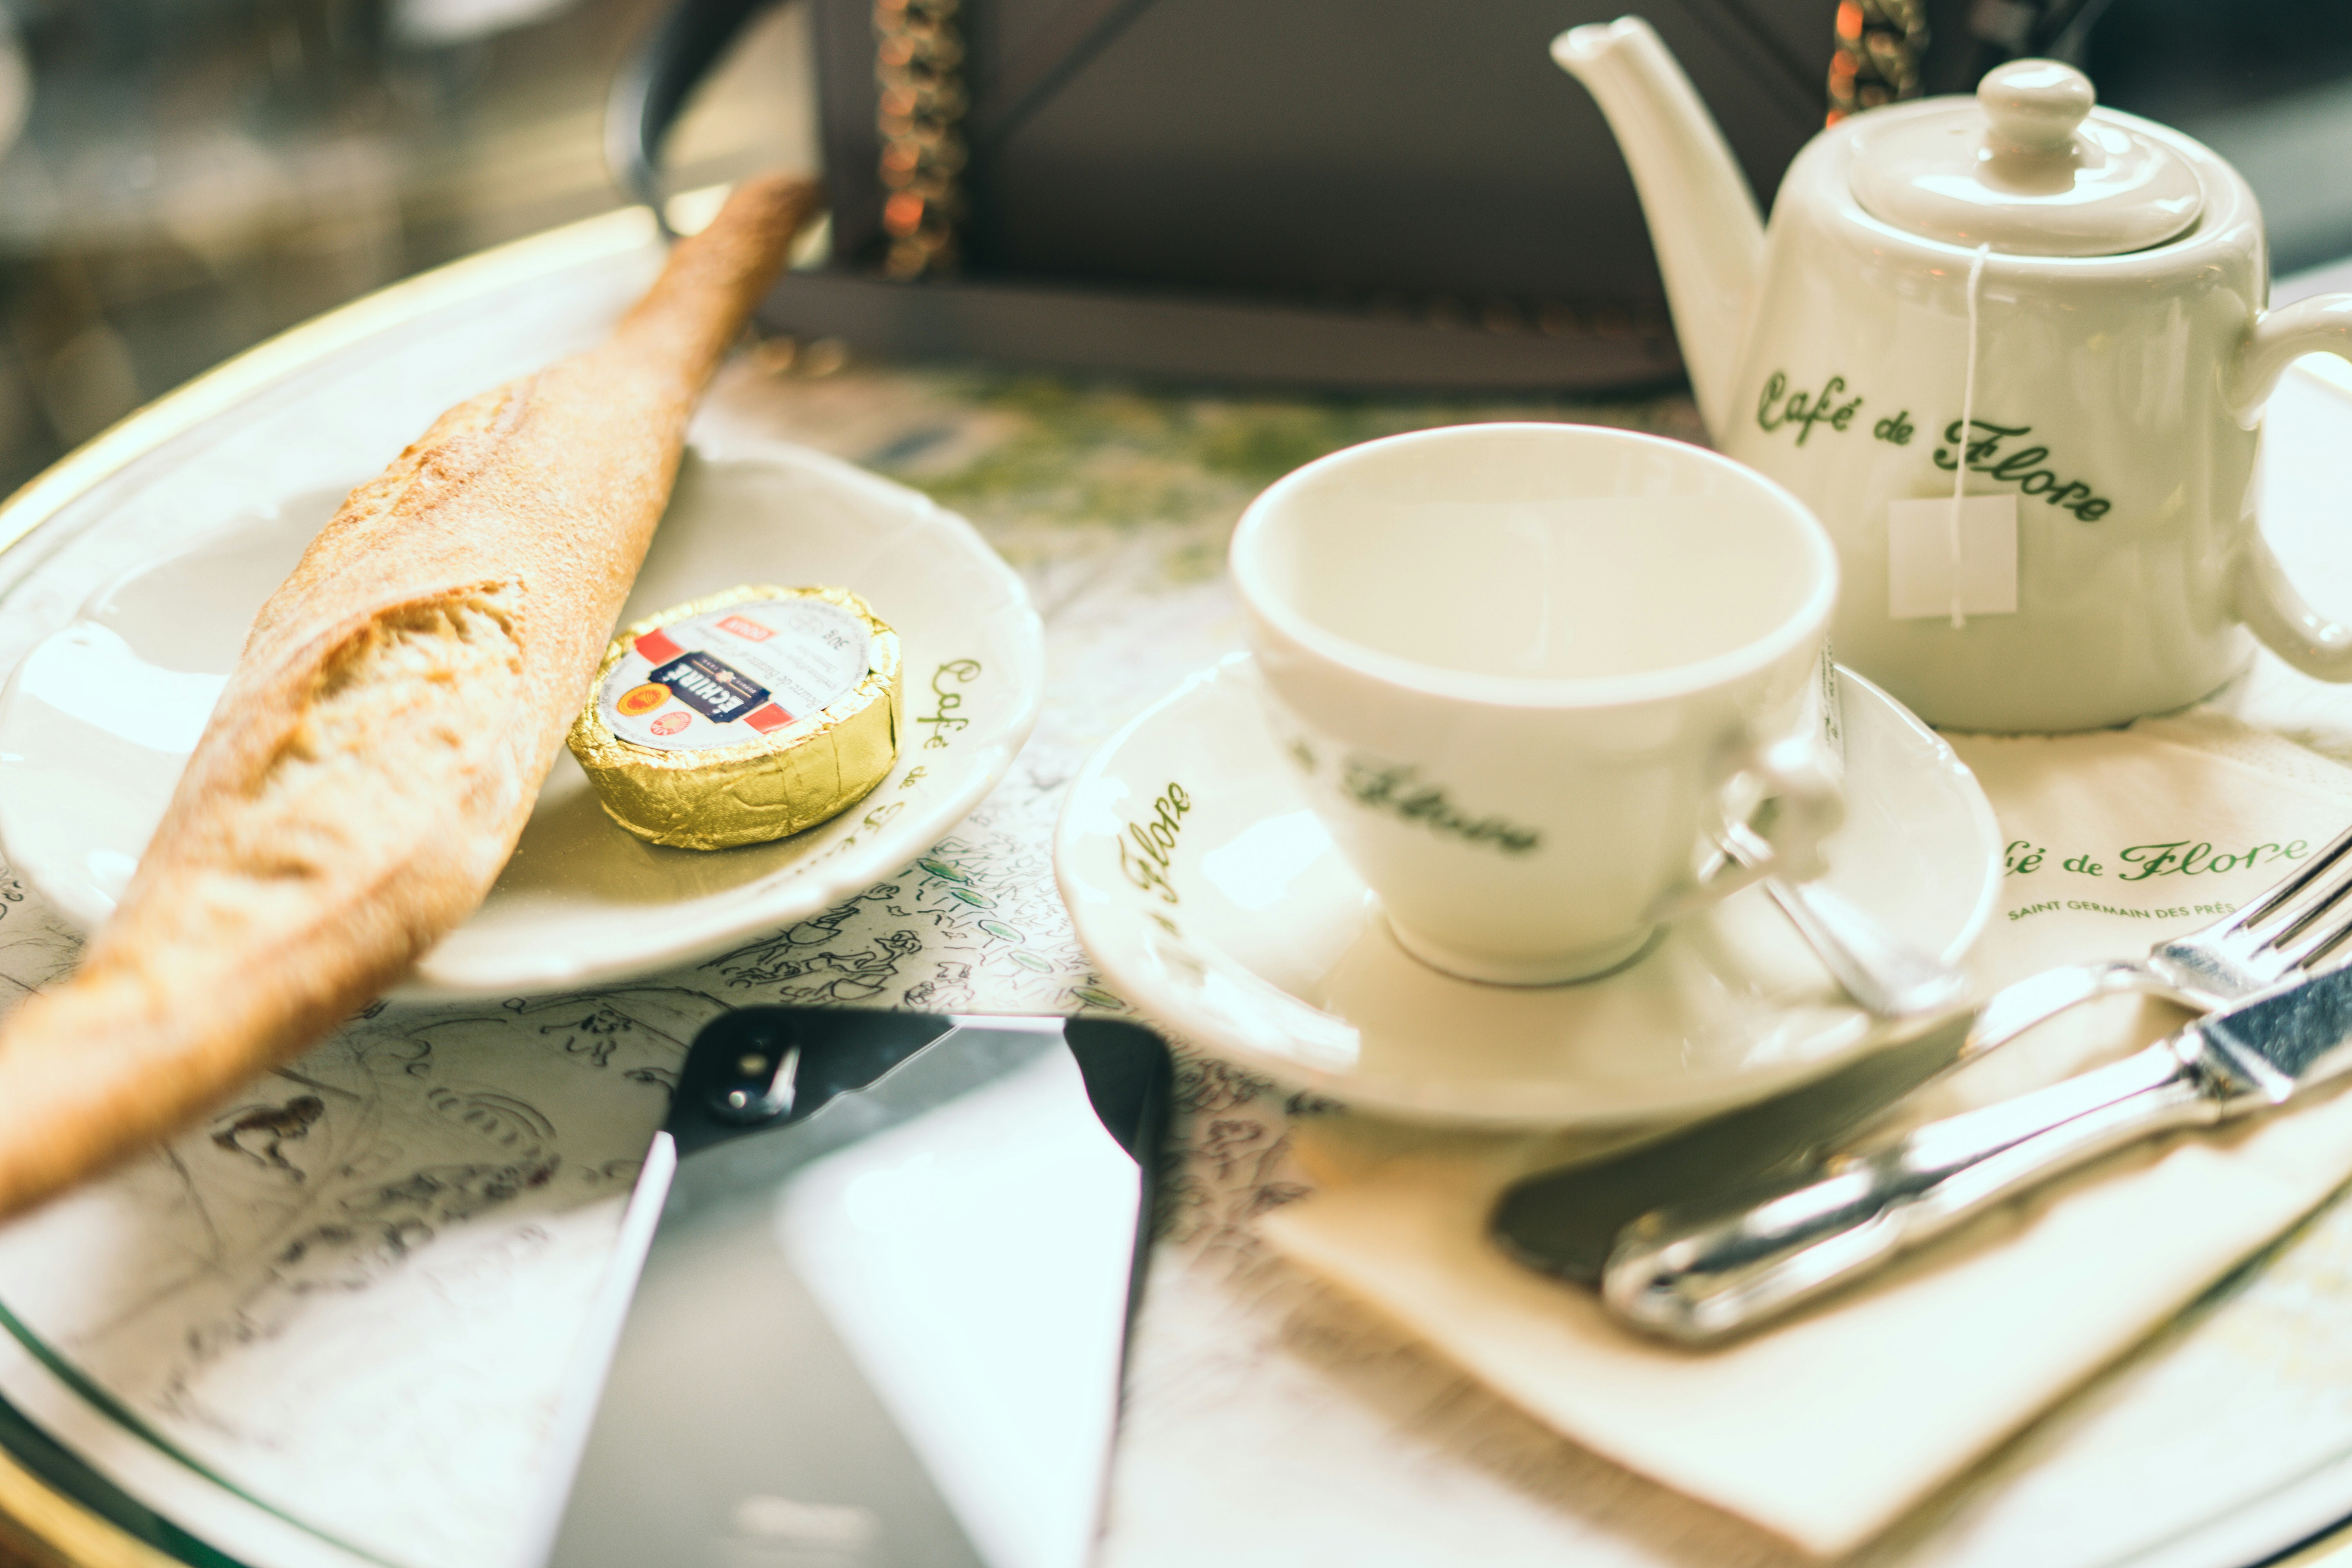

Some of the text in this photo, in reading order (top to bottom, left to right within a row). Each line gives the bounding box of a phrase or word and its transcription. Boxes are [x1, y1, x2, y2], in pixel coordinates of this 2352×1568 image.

[1757, 370, 2112, 522] Café de Flore
[662, 662, 744, 714] ÉCHIRÉ
[735, 680, 757, 693] DEPUIS
[775, 675, 792, 686] de
[789, 684, 822, 709] Beurre
[917, 659, 981, 749] Café
[1116, 781, 1191, 904] Flore
[2062, 854, 2103, 877] de
[2118, 839, 2310, 882] Flore
[2007, 900, 2236, 921] SAINT GERMAIN DES PRÉS
